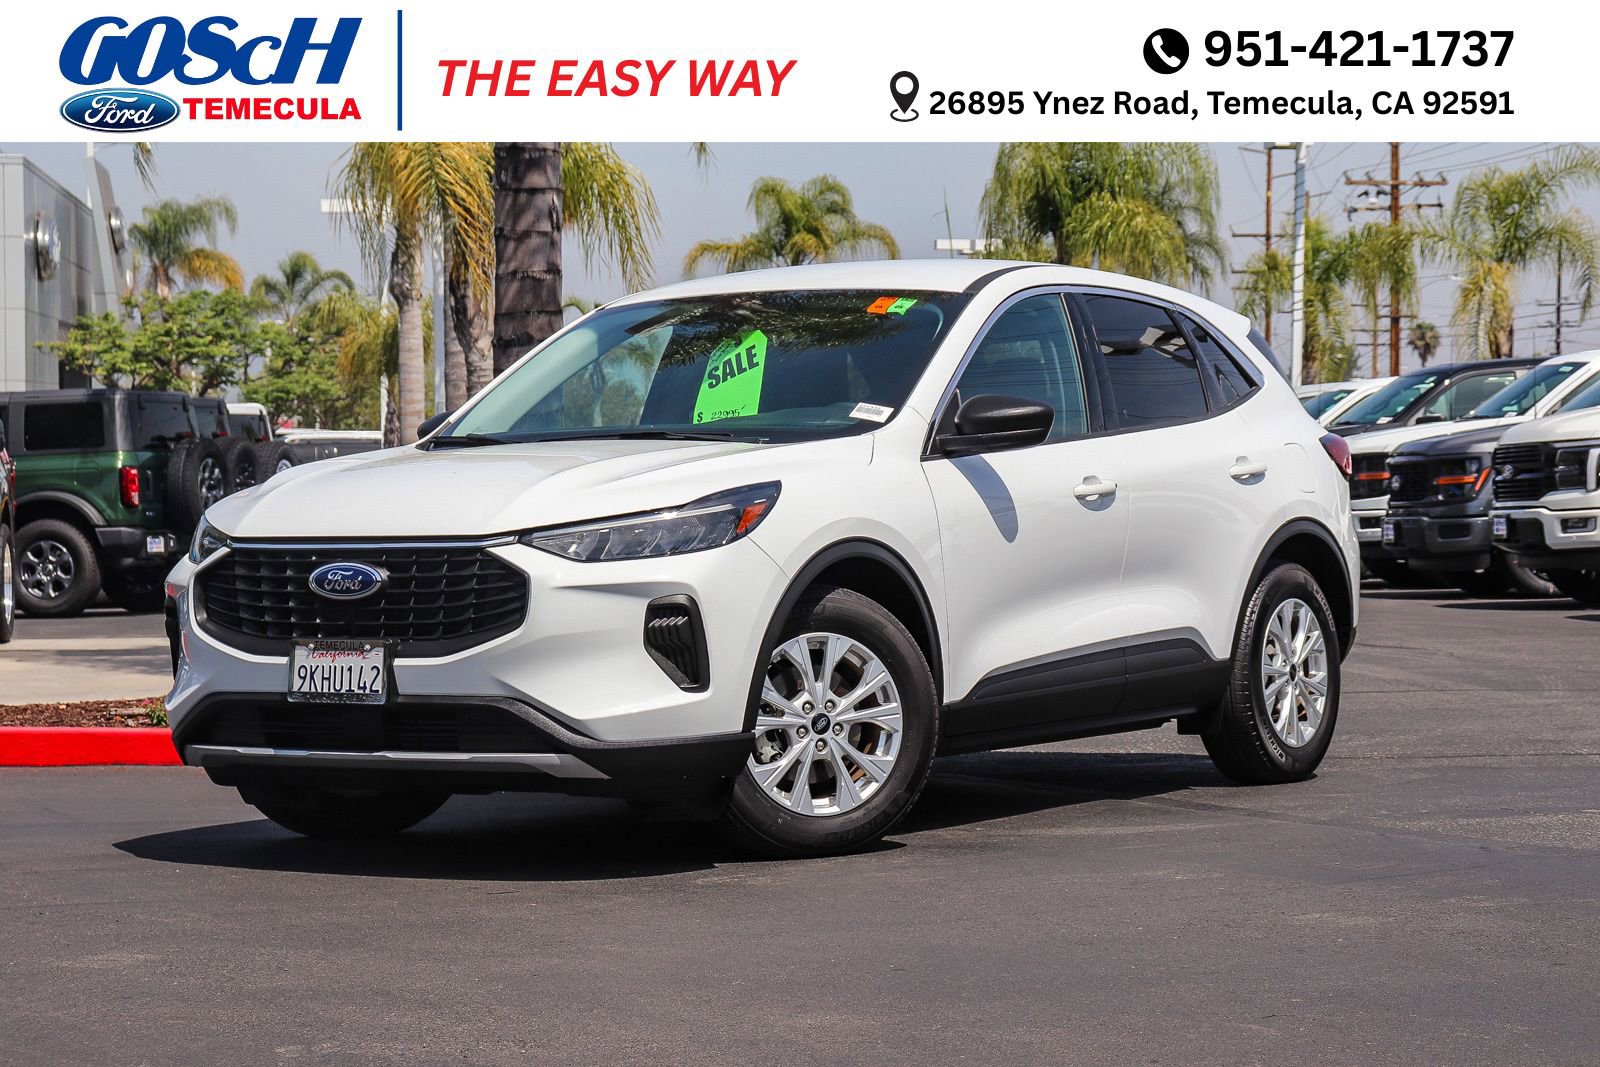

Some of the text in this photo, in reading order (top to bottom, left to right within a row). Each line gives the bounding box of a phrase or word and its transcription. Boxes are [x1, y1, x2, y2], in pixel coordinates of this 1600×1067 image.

[707, 344, 760, 389] SALE
[323, 569, 363, 591] Ford
[314, 640, 364, 651] TEMECULA
[311, 650, 369, 664] California
[297, 664, 381, 694] 9KHU142
